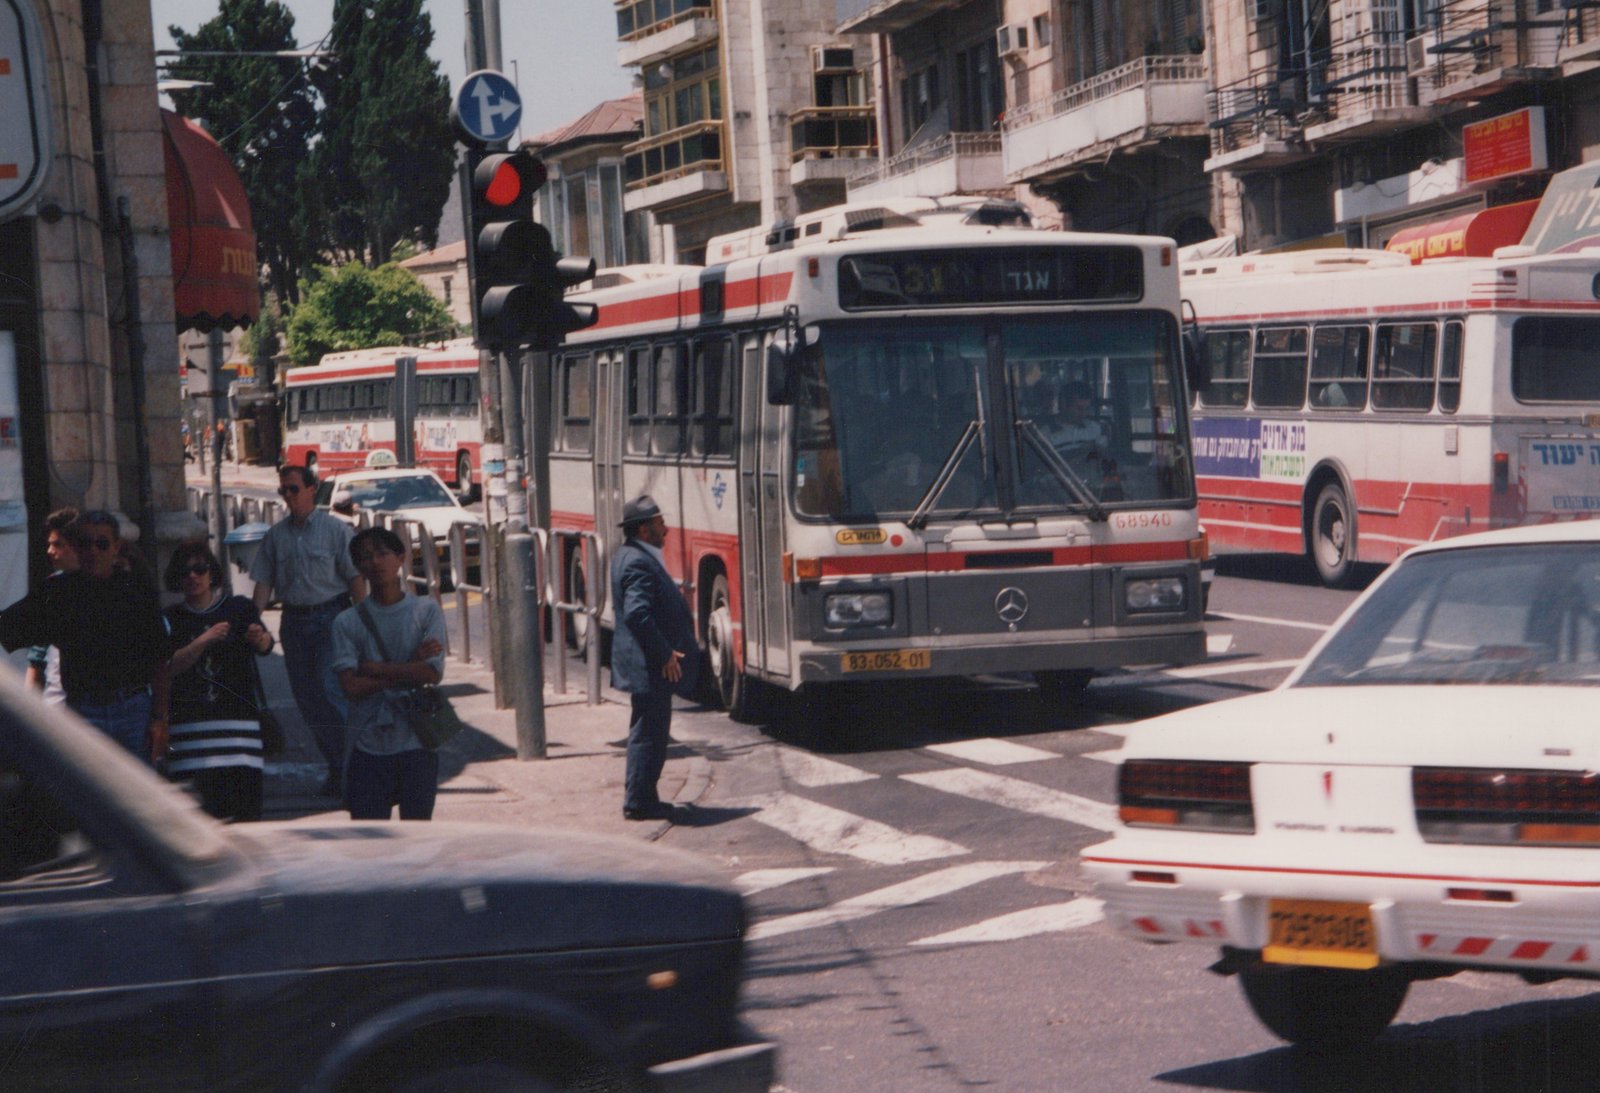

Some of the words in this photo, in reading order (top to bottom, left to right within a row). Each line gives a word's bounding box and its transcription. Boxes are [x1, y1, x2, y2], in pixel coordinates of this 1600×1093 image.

[1007, 270, 1050, 291] אגד
[1290, 425, 1306, 452] בנק
[1532, 444, 1584, 465] יעוד
[1116, 512, 1173, 529] 68940
